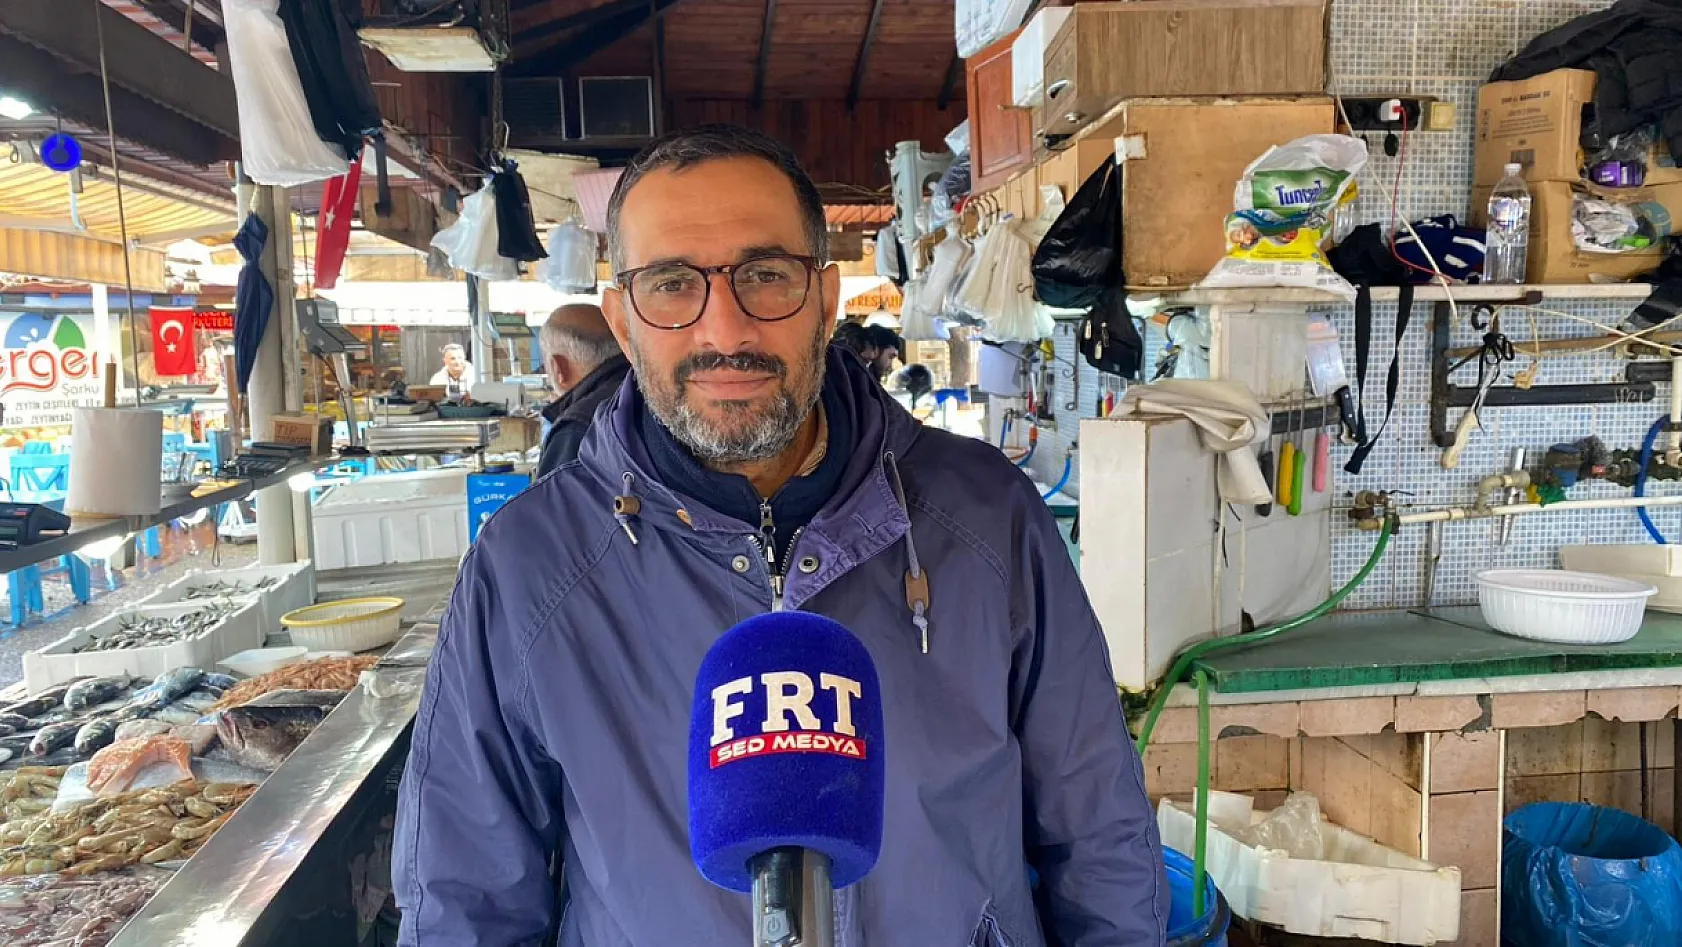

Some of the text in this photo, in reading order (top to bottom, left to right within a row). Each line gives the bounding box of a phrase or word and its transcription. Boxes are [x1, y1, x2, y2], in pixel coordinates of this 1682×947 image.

[710, 671, 861, 747] FRT
[717, 734, 860, 762] SED MEDYA
